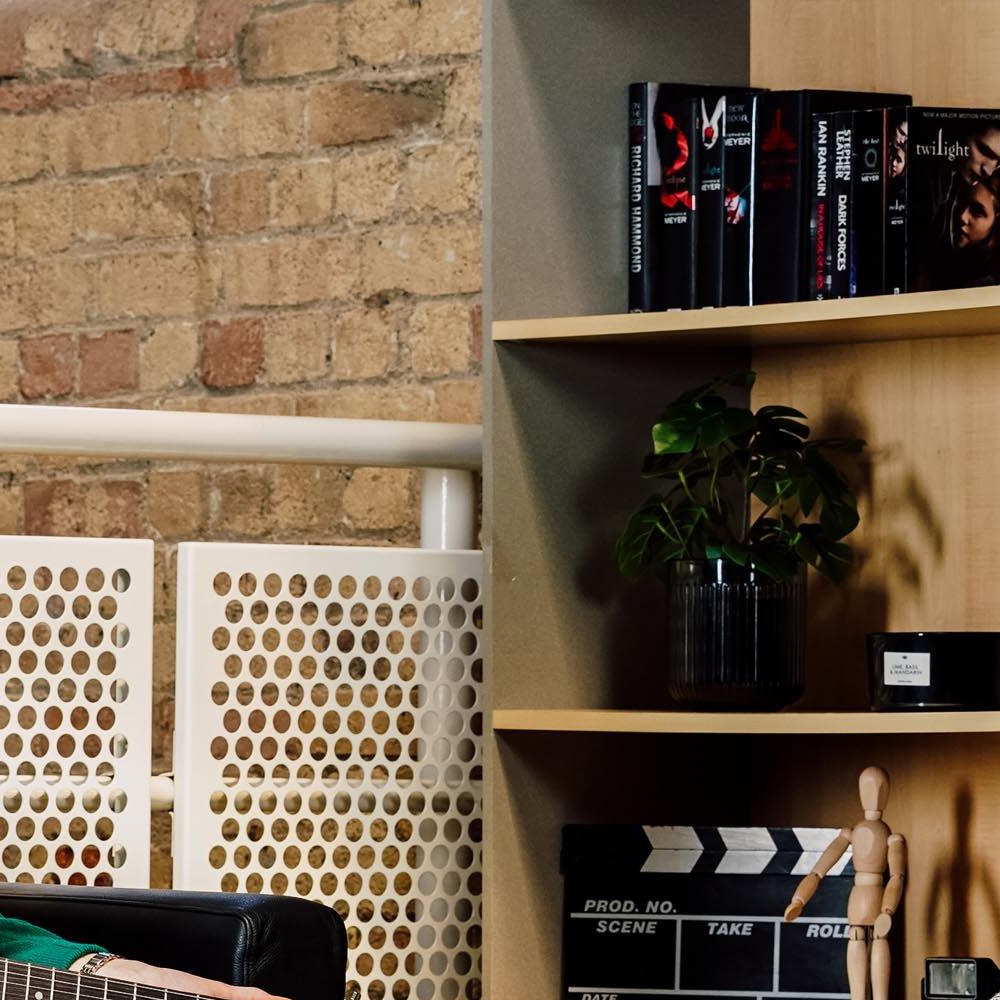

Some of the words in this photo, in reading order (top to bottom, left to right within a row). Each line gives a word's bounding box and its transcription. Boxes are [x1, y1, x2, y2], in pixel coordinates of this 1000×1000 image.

[817, 121, 828, 144] IAN
[916, 128, 970, 161] twilight
[631, 145, 642, 202] RICHARD
[816, 147, 828, 197] RANKIN
[835, 131, 845, 179] LEATHER
[843, 129, 852, 181] STEPHEN
[837, 194, 848, 226] DARK
[631, 206, 642, 273] HAMMOND
[837, 228, 847, 271] FORCES
[584, 900, 639, 914] PROD.
[646, 901, 678, 914] NO.
[596, 920, 658, 934] SCENE
[708, 923, 754, 937] TAKE
